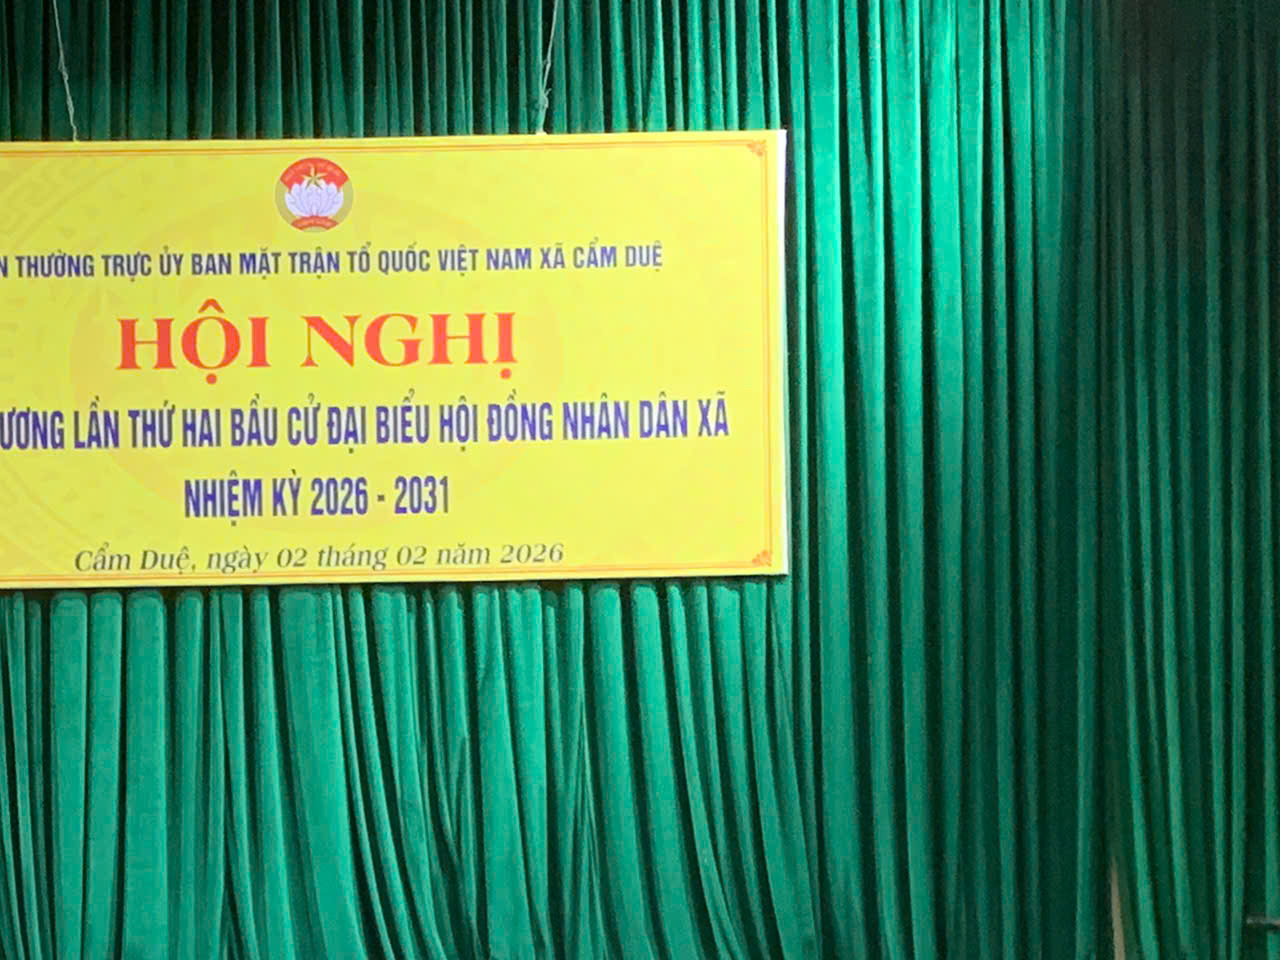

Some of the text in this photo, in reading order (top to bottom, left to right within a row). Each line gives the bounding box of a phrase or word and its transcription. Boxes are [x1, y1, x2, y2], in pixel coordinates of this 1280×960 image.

[15, 248, 95, 278] THƯỜNG
[101, 251, 152, 283] TRỰC
[158, 245, 185, 277] ỦY
[191, 252, 232, 276] BAN
[239, 247, 282, 280] MẶT
[287, 245, 341, 279] TRẬN
[347, 239, 371, 273] TỔ
[378, 241, 431, 273] QUỐC
[437, 243, 479, 277] VIỆT
[486, 247, 532, 271] NAM
[539, 242, 566, 269] XÃ
[572, 236, 617, 269] CẨM
[625, 240, 664, 273] DUỆ
[115, 298, 518, 384] HỘI NGHỊ
[73, 395, 120, 450] LẦN
[128, 399, 176, 449] THỨ
[182, 408, 222, 448] HAI
[230, 393, 277, 447] BẦU
[287, 393, 322, 446] CỬ
[327, 403, 367, 454] ĐẠI
[375, 388, 431, 445] BIỂU
[439, 395, 479, 453] HỘI
[487, 389, 554, 443] ĐỒNG
[562, 391, 630, 442] NHÂN
[639, 391, 689, 439] DÂN
[697, 391, 730, 438] XÃ
[184, 468, 450, 527] NHIỆM KỲ 2026 - 2031
[74, 542, 564, 576] Cẩm Duệ, ngày 02 tháng 02 năm 2026
